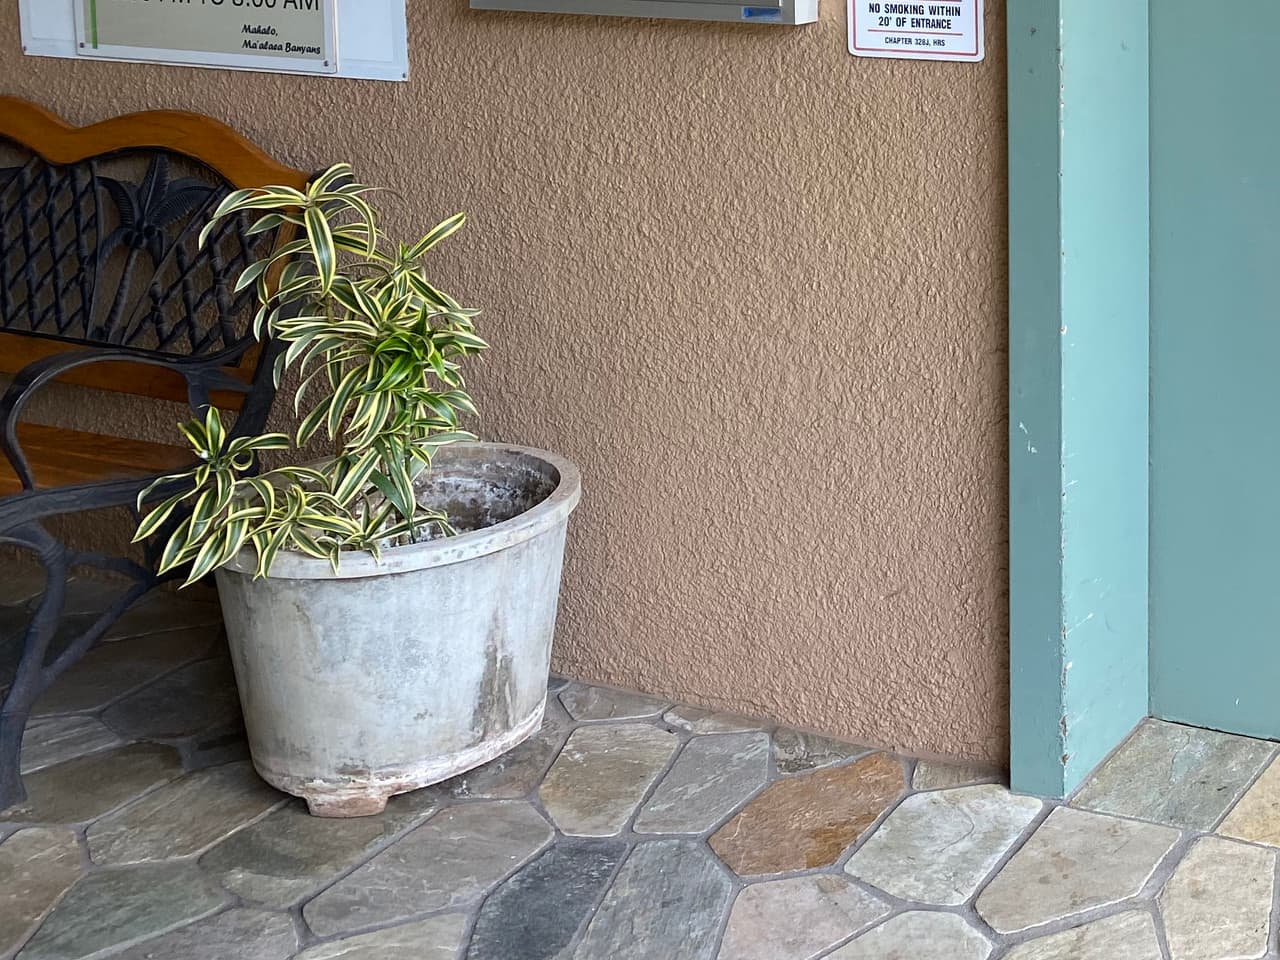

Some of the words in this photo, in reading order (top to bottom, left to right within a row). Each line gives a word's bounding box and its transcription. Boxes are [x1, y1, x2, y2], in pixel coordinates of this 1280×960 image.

[869, 3, 881, 14] NO
[884, 3, 924, 16] SMOKING
[929, 5, 961, 17] WITHIN
[878, 16, 892, 27] 20'
[896, 17, 907, 28] OF
[911, 17, 952, 30] ENTRANCE
[241, 24, 278, 36] Mahalo,
[884, 36, 912, 45] CHAPTER
[932, 39, 946, 47] HRS
[285, 42, 320, 54] Banyans
